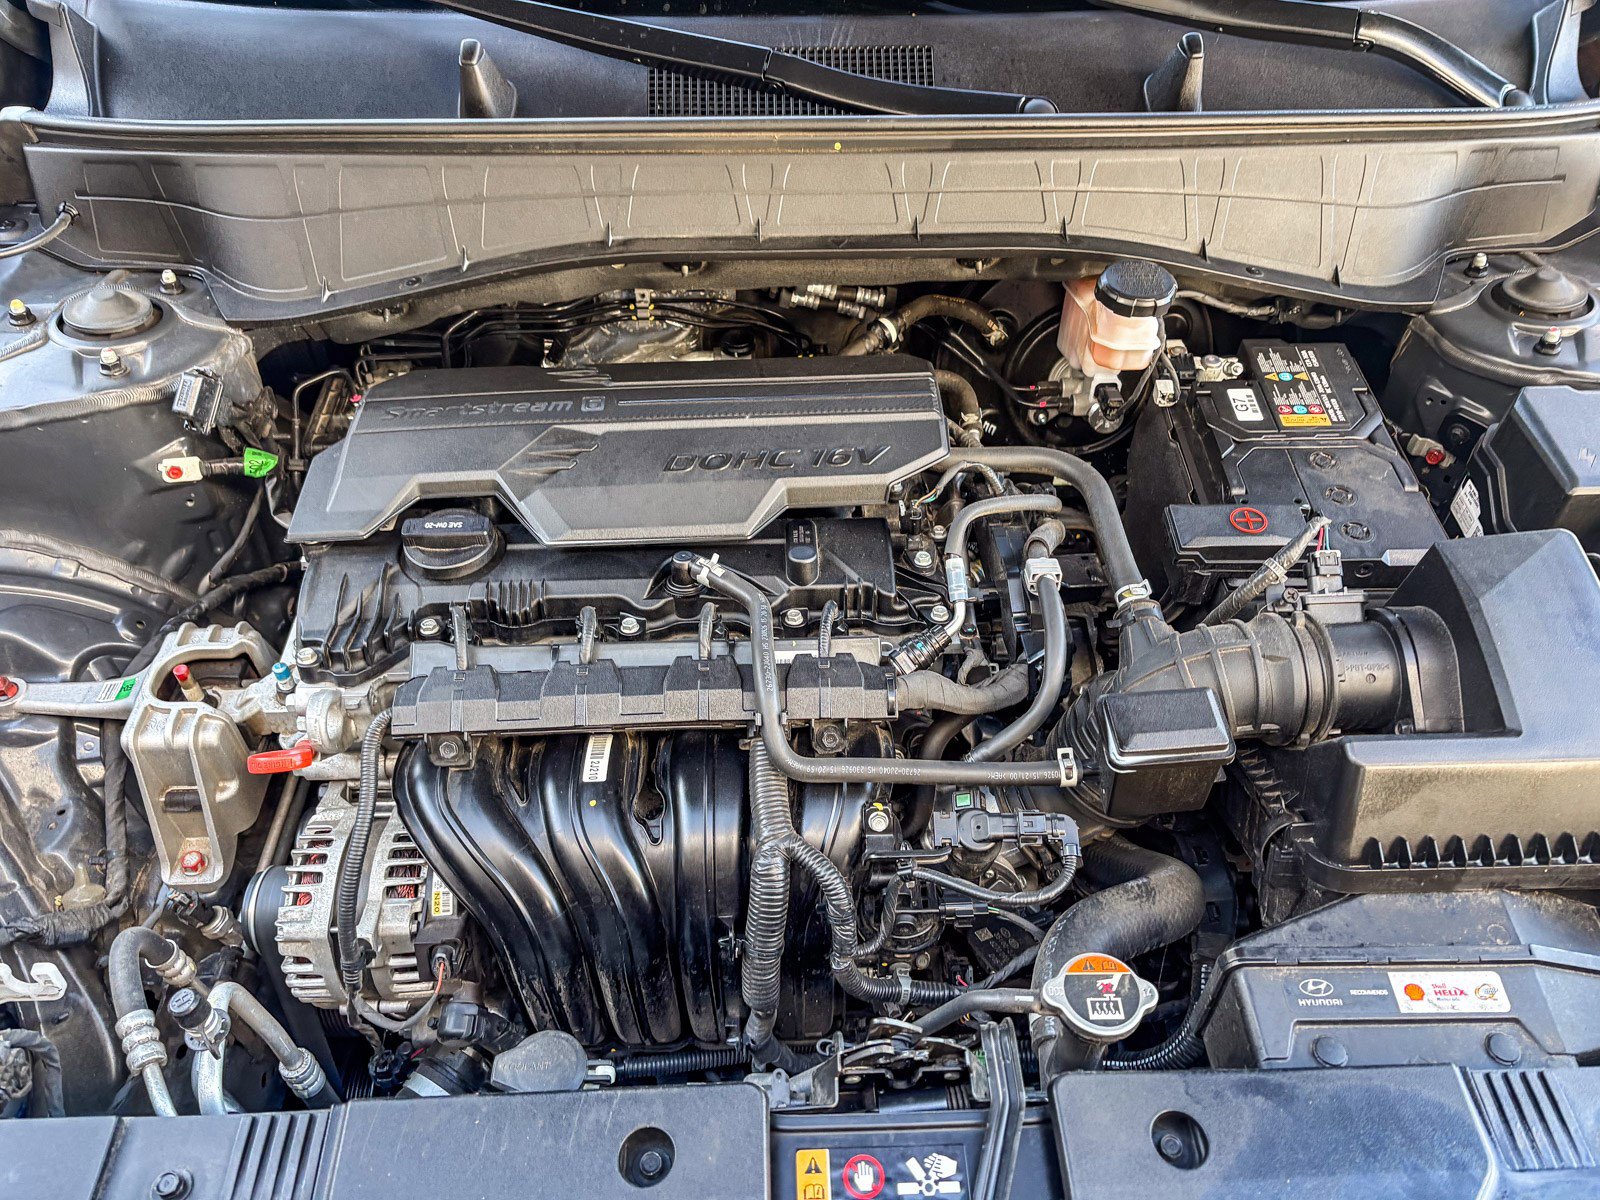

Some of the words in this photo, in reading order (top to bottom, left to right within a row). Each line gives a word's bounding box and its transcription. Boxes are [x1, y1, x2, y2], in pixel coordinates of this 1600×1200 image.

[382, 400, 573, 420] Smartstream
[1232, 398, 1249, 412] G7
[663, 449, 801, 473] DOHC
[812, 445, 891, 468] 16V
[588, 760, 601, 781] 2J210
[867, 765, 876, 774] HS
[1434, 988, 1469, 996] HELIX
[1298, 999, 1343, 1007] HYUNDAI
